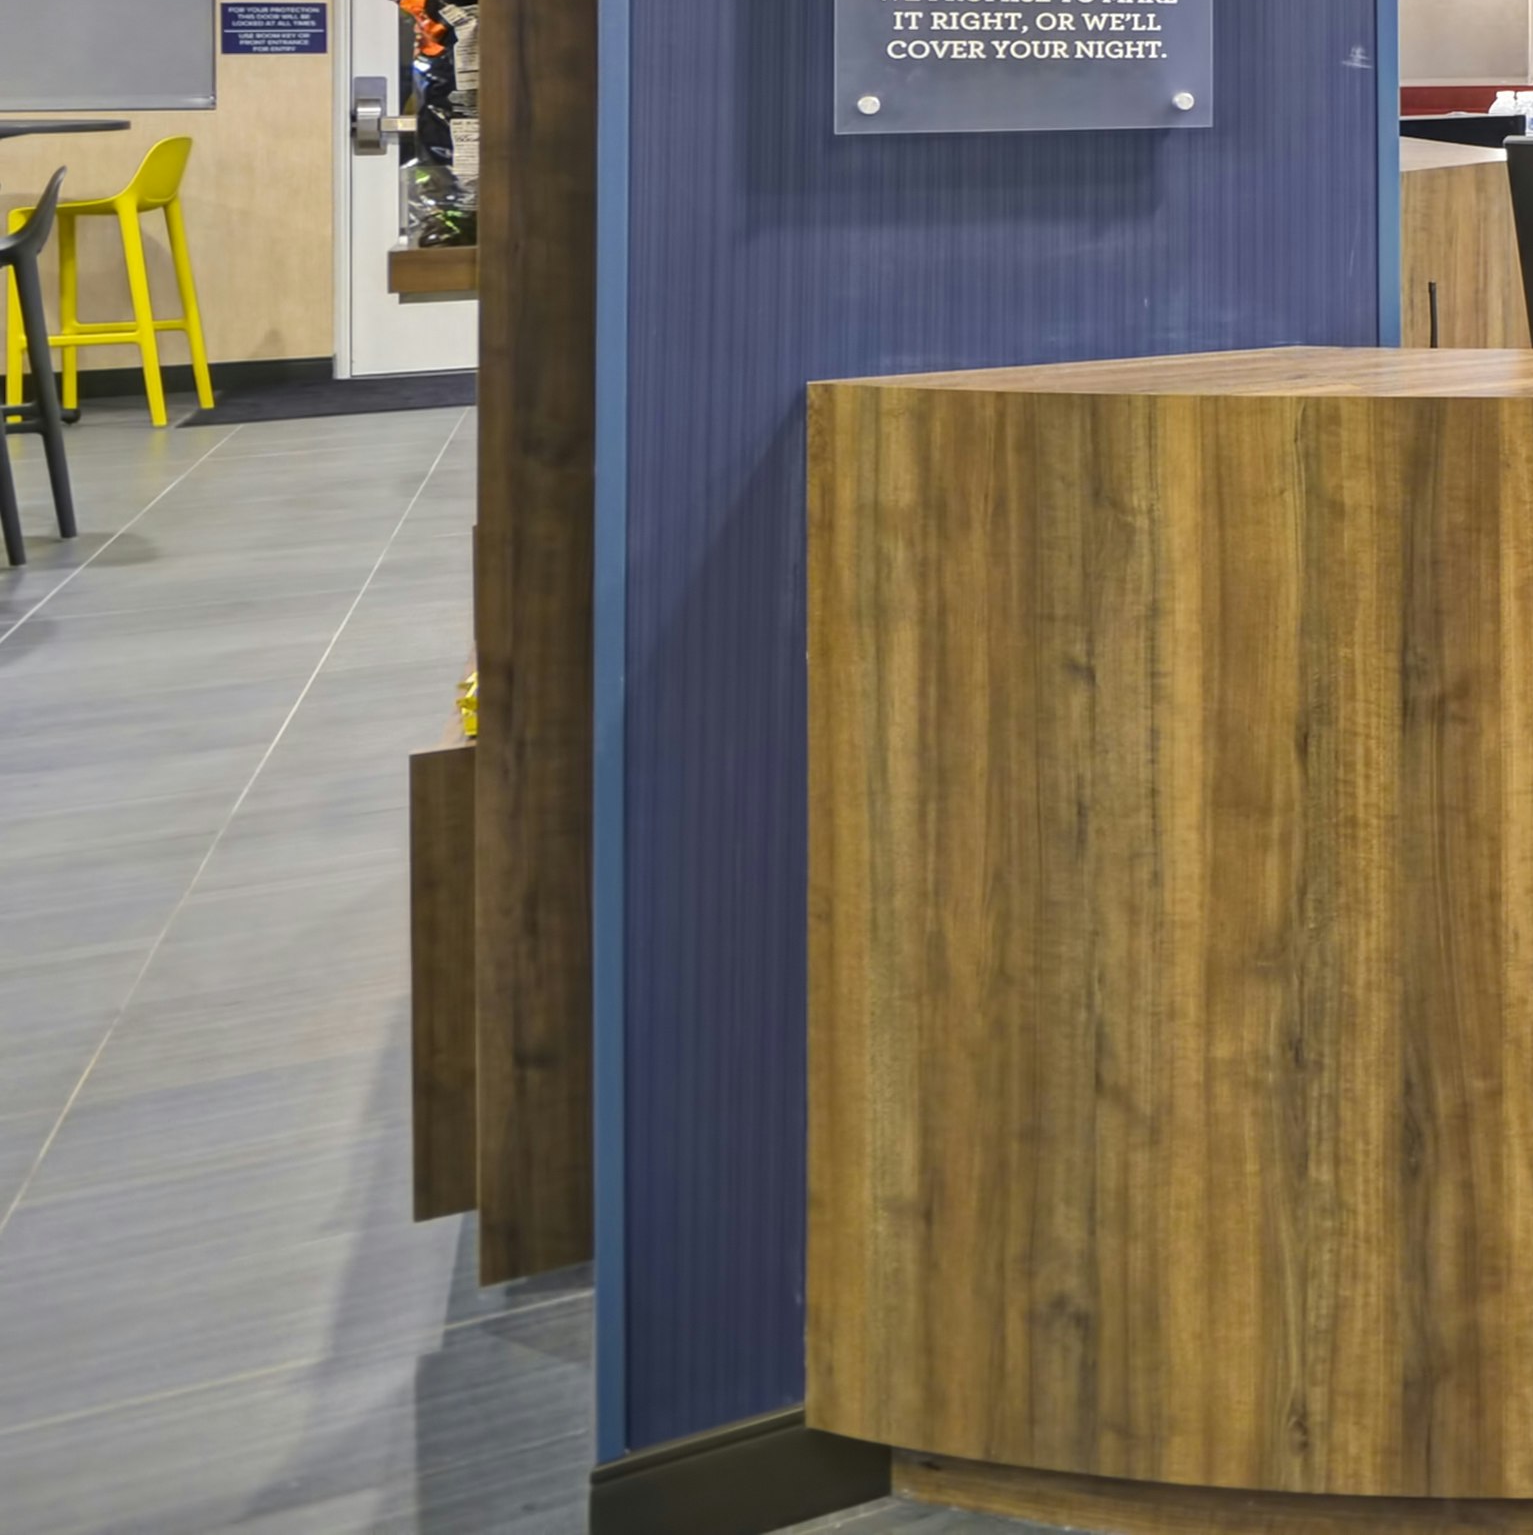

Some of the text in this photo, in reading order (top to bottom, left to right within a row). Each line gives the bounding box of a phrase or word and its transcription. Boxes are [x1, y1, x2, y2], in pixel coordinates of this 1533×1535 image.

[894, 12, 1161, 33] IT RIGHT, OR WE’LL
[887, 40, 1167, 59] COVER YOUR NIGHT.
